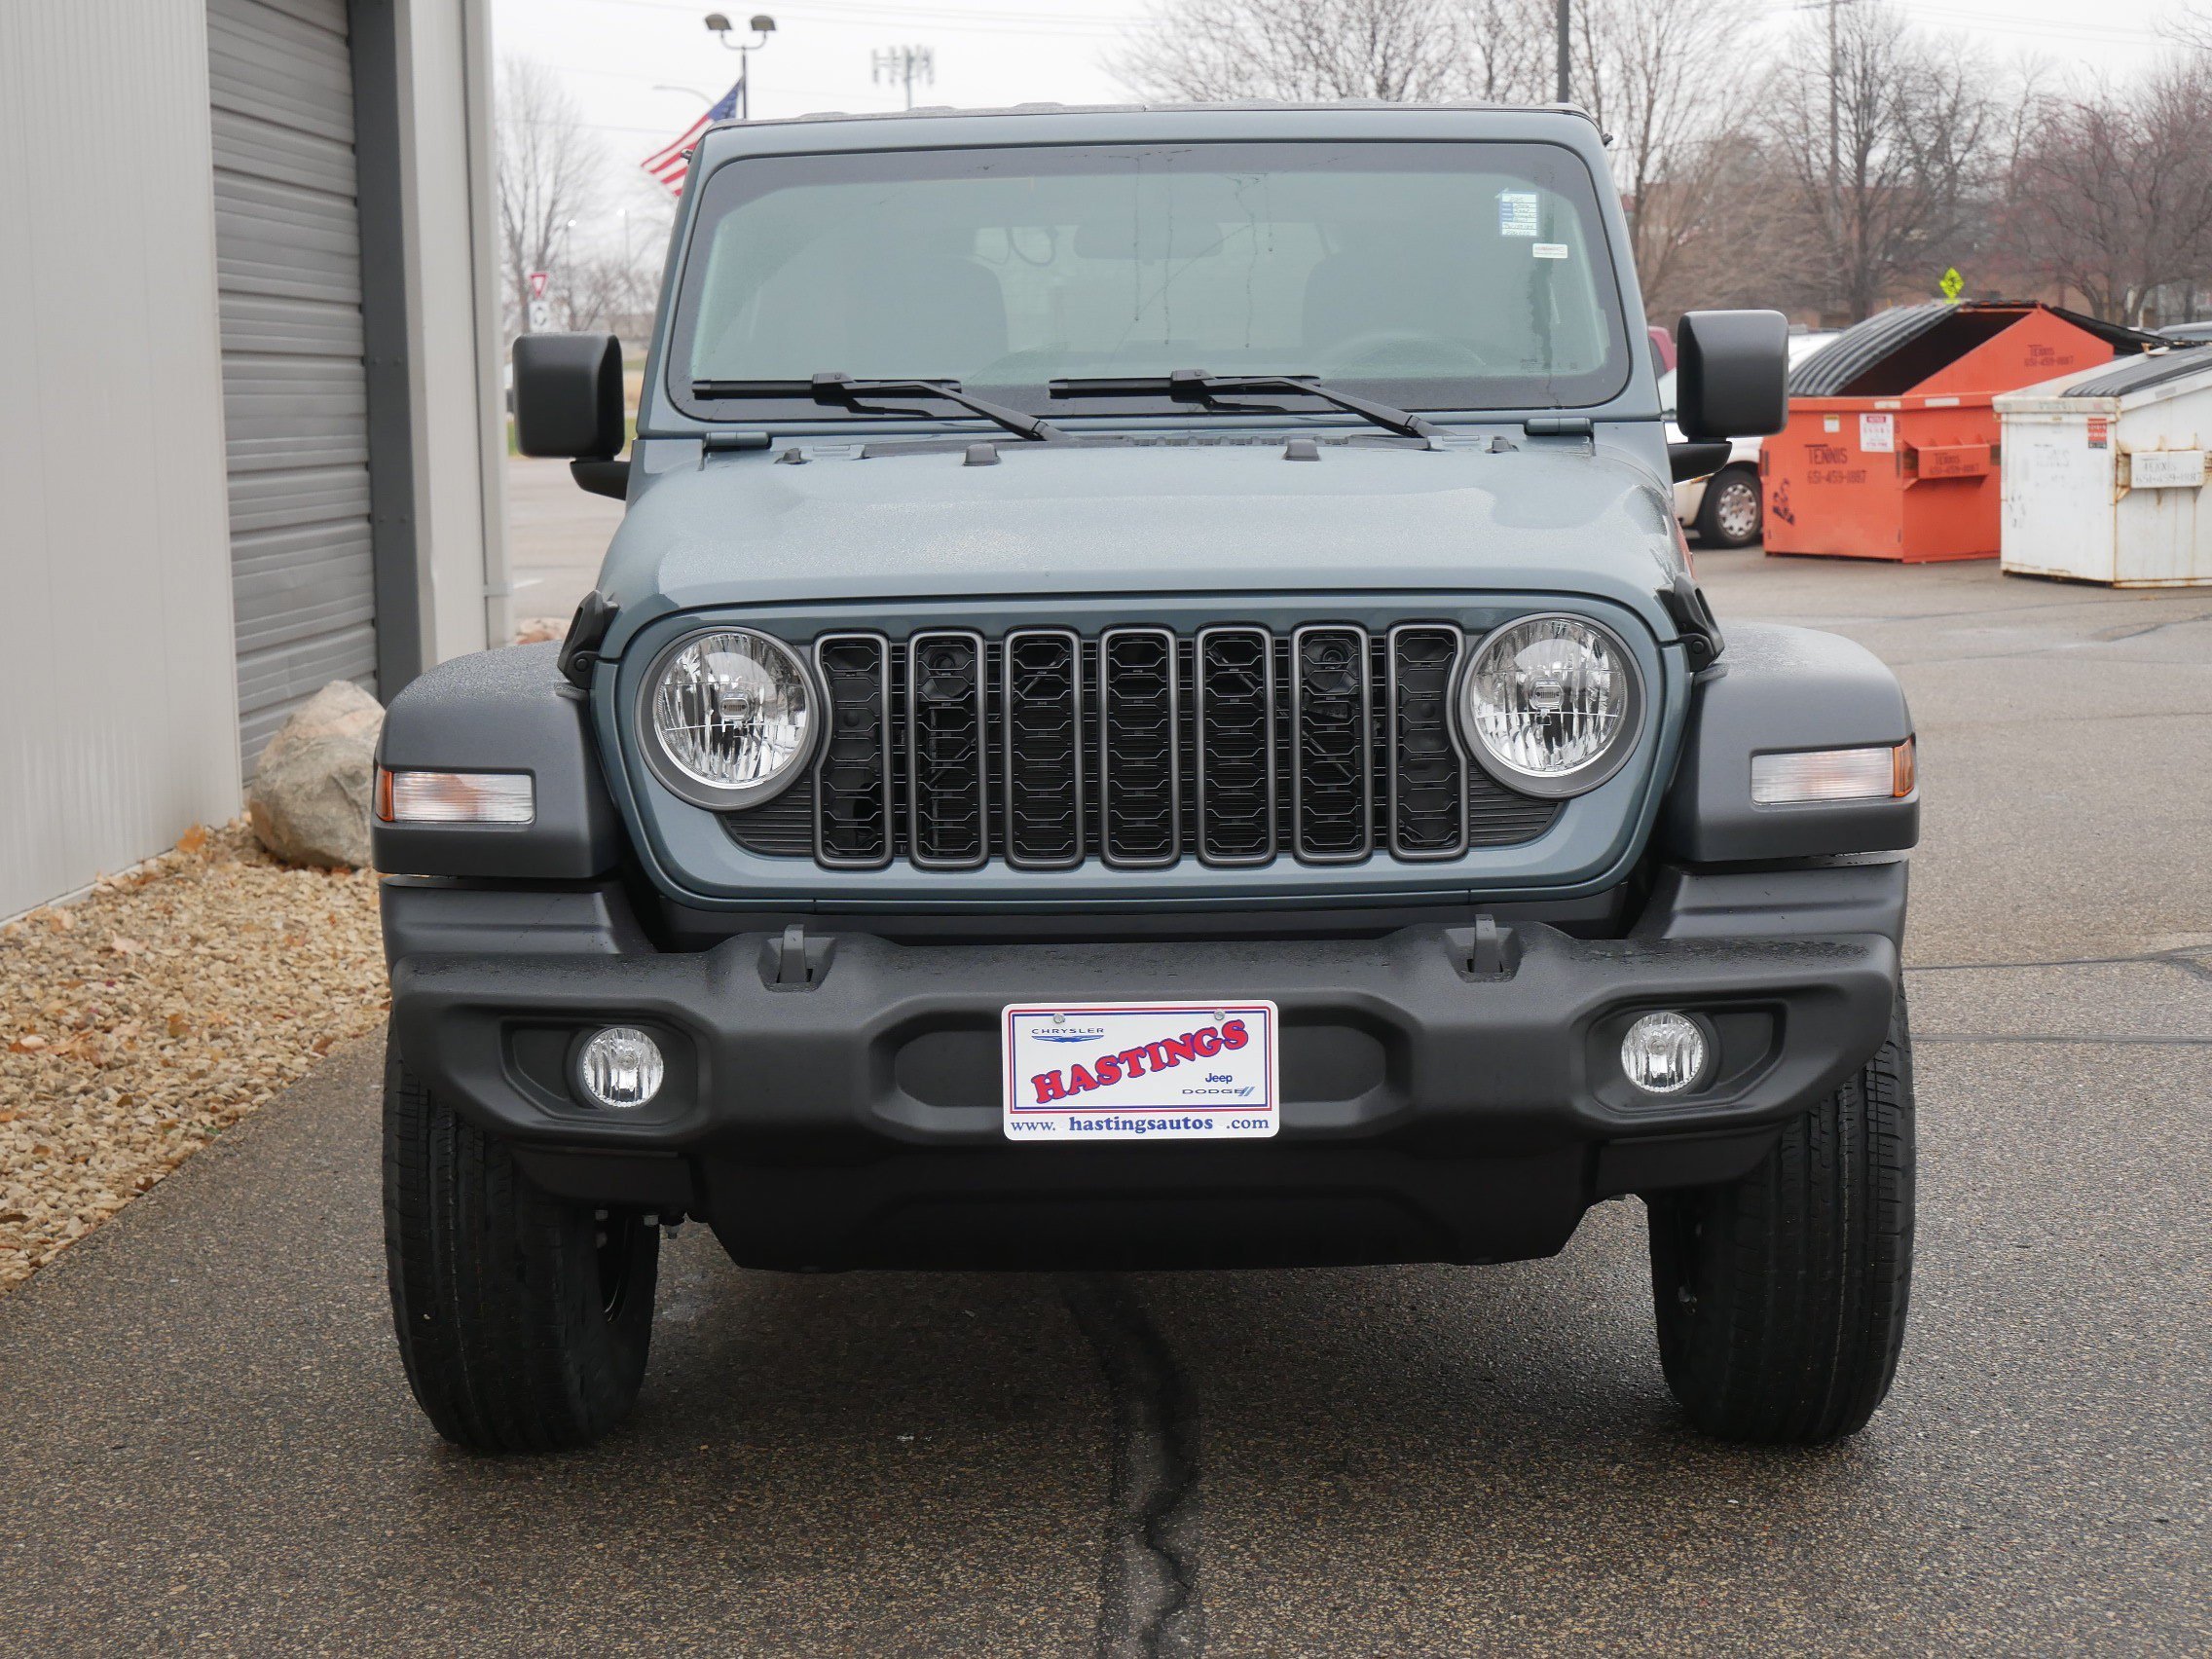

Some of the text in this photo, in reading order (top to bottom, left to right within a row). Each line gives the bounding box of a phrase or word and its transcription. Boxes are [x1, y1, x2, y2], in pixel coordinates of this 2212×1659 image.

[1804, 444, 1848, 464] TENNIS
[1030, 1019, 1249, 1104] HASTINGS
[1204, 1073, 1233, 1084] Jeep
[1010, 1116, 1270, 1133] www. hastingsautos .com
